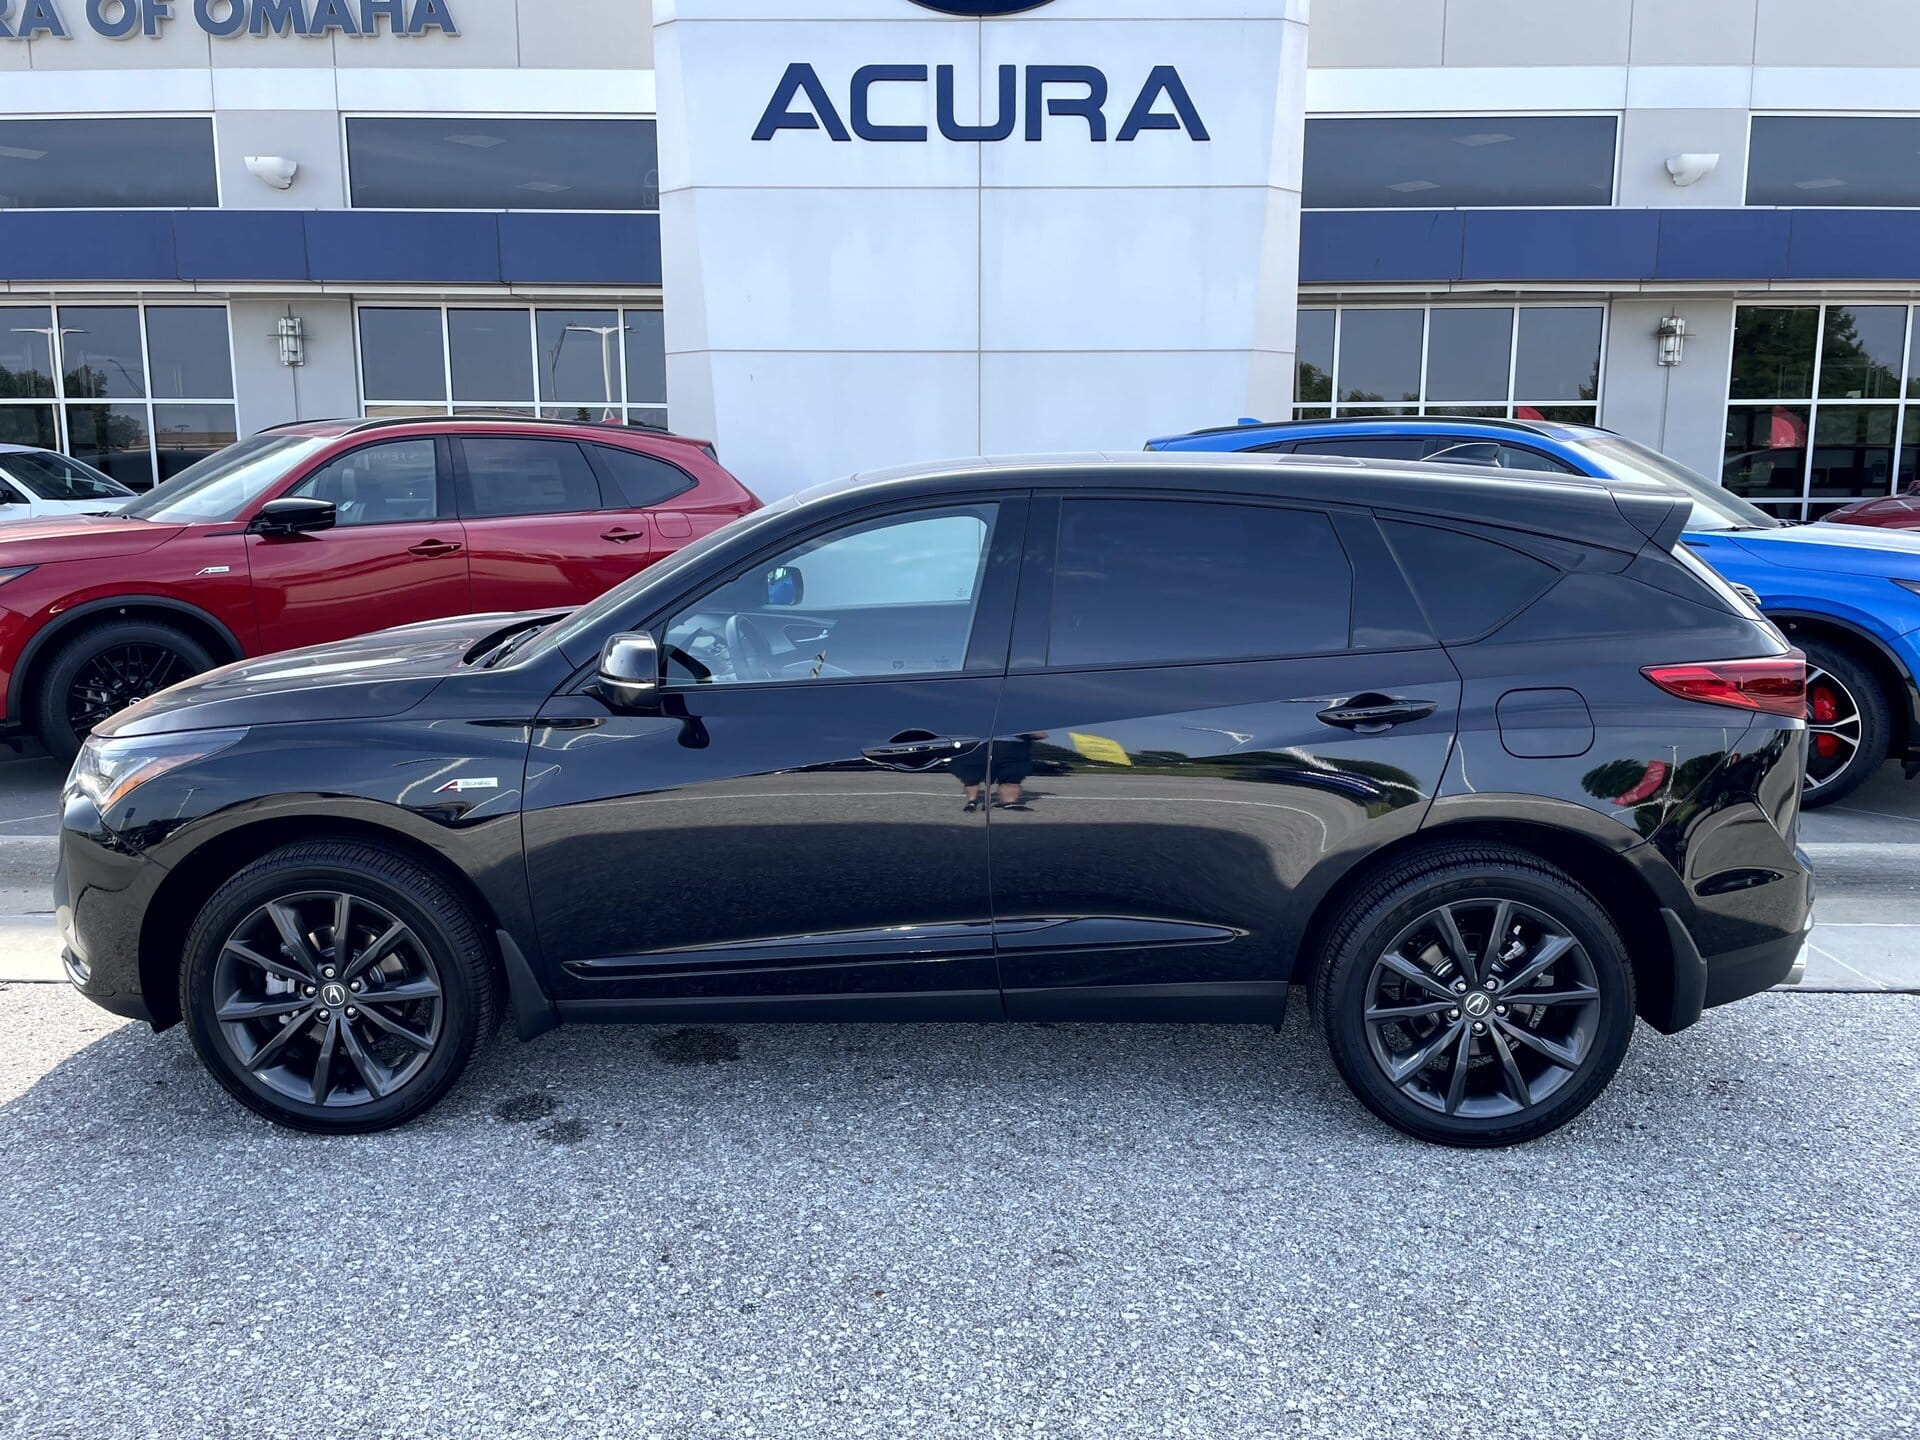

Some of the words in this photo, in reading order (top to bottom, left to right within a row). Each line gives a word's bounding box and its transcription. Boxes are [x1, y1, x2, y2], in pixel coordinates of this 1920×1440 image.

[86, 0, 172, 38] OF
[194, 0, 459, 37] OMAHA
[751, 63, 1210, 142] ACURA
